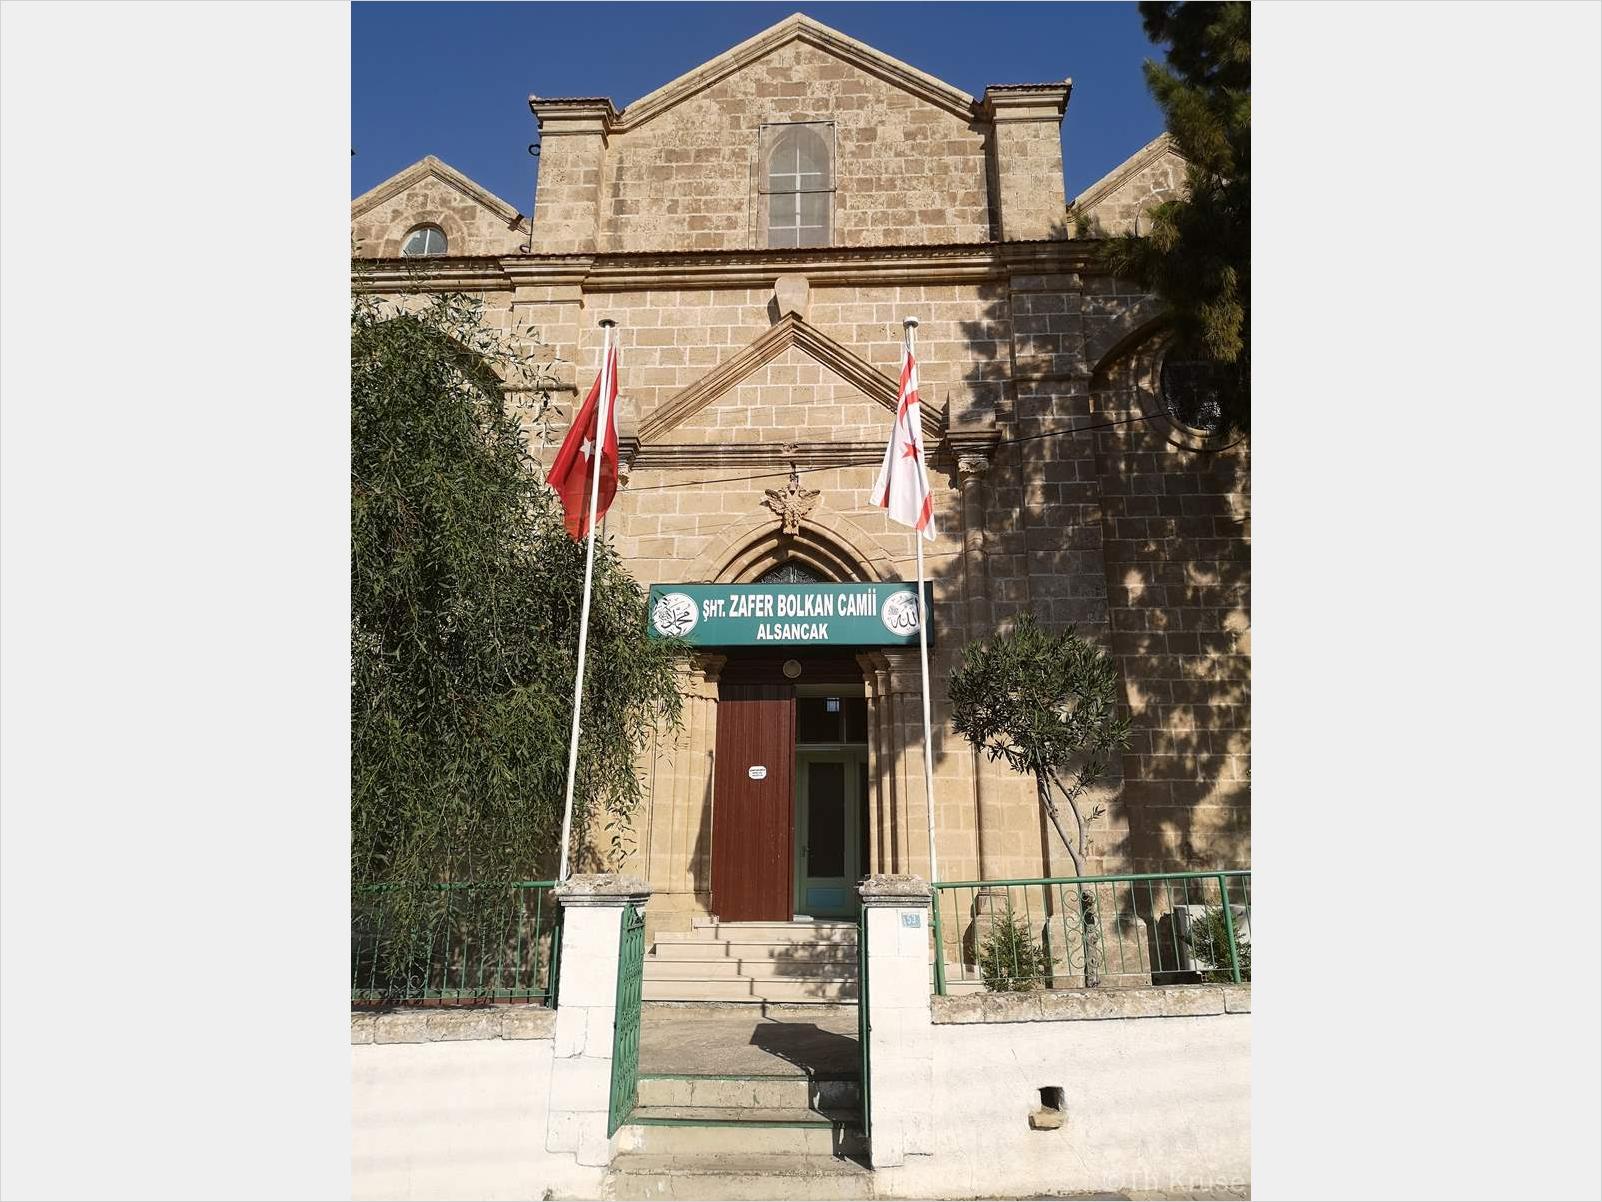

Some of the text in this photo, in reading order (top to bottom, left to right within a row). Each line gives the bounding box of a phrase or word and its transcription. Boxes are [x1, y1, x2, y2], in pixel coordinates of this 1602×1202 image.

[703, 599, 726, 622] ŞHT.
[729, 594, 774, 617] ZAFER
[777, 593, 834, 617] BOLKAN
[756, 623, 829, 640] ALSANCAK
